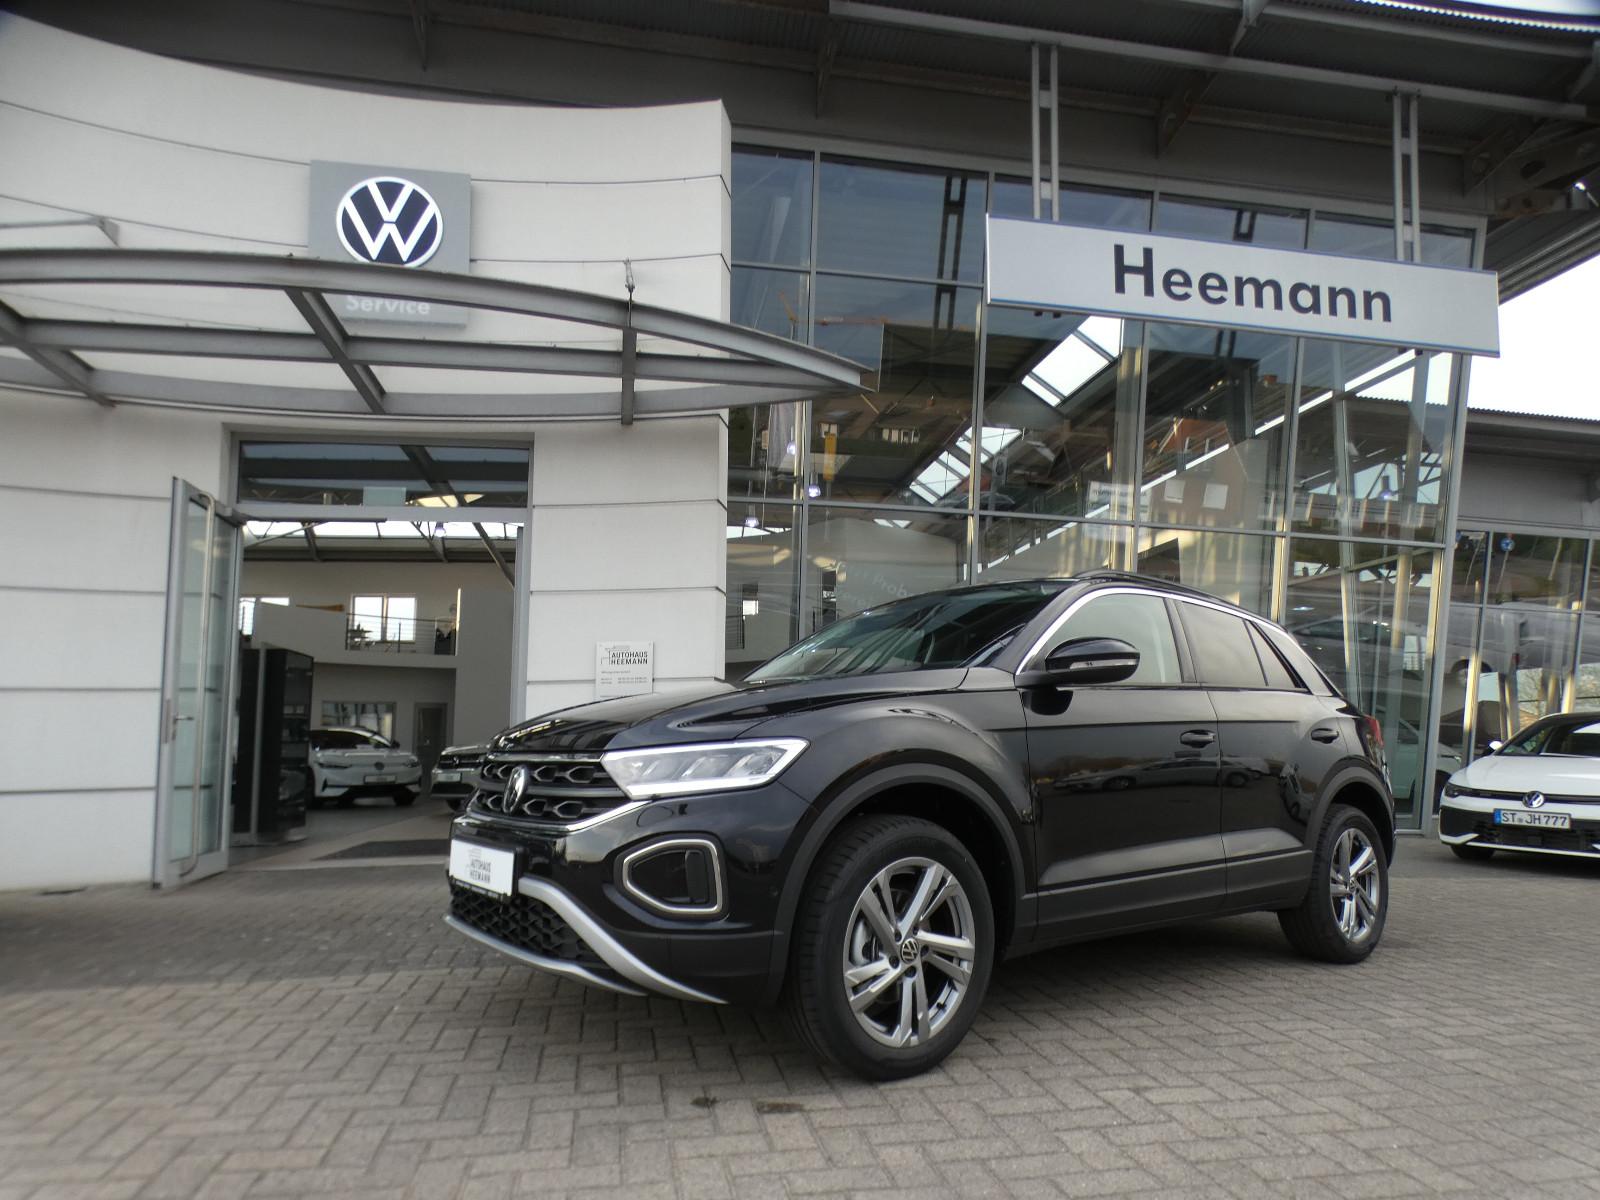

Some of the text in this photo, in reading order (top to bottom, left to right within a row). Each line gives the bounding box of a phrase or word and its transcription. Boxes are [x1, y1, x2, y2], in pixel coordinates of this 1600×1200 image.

[1113, 243, 1392, 323] Heemann
[345, 294, 430, 315] Service
[1502, 812, 1567, 827] ST JH 777
